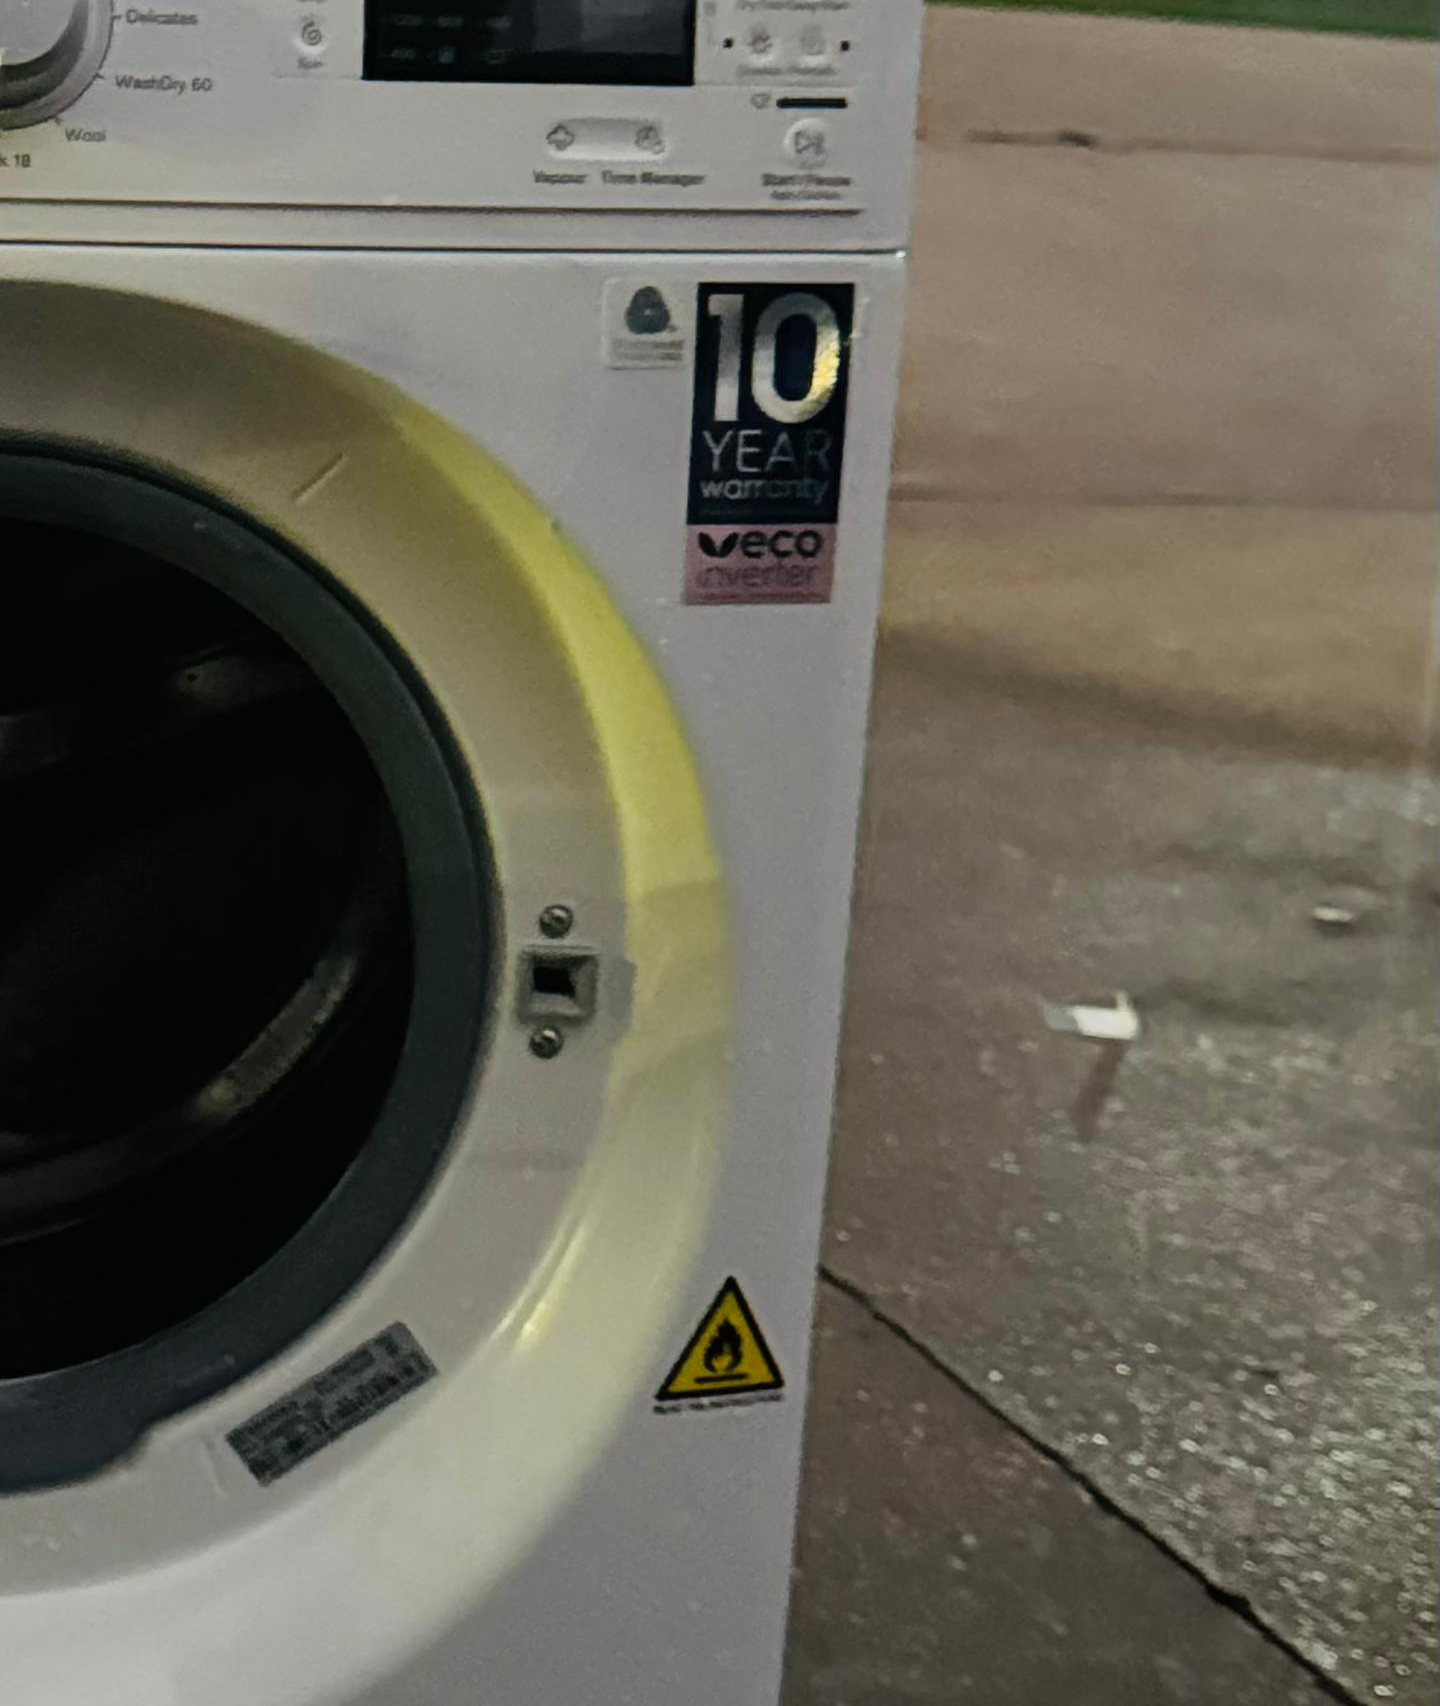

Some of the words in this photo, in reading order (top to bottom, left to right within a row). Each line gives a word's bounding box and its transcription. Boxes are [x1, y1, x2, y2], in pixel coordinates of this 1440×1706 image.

[126, 10, 198, 25] Delicates
[707, 293, 841, 424] 10
[702, 429, 833, 473] YEAR
[700, 477, 829, 504] warranty
[740, 530, 822, 560] eco
[696, 562, 818, 588] inverter
